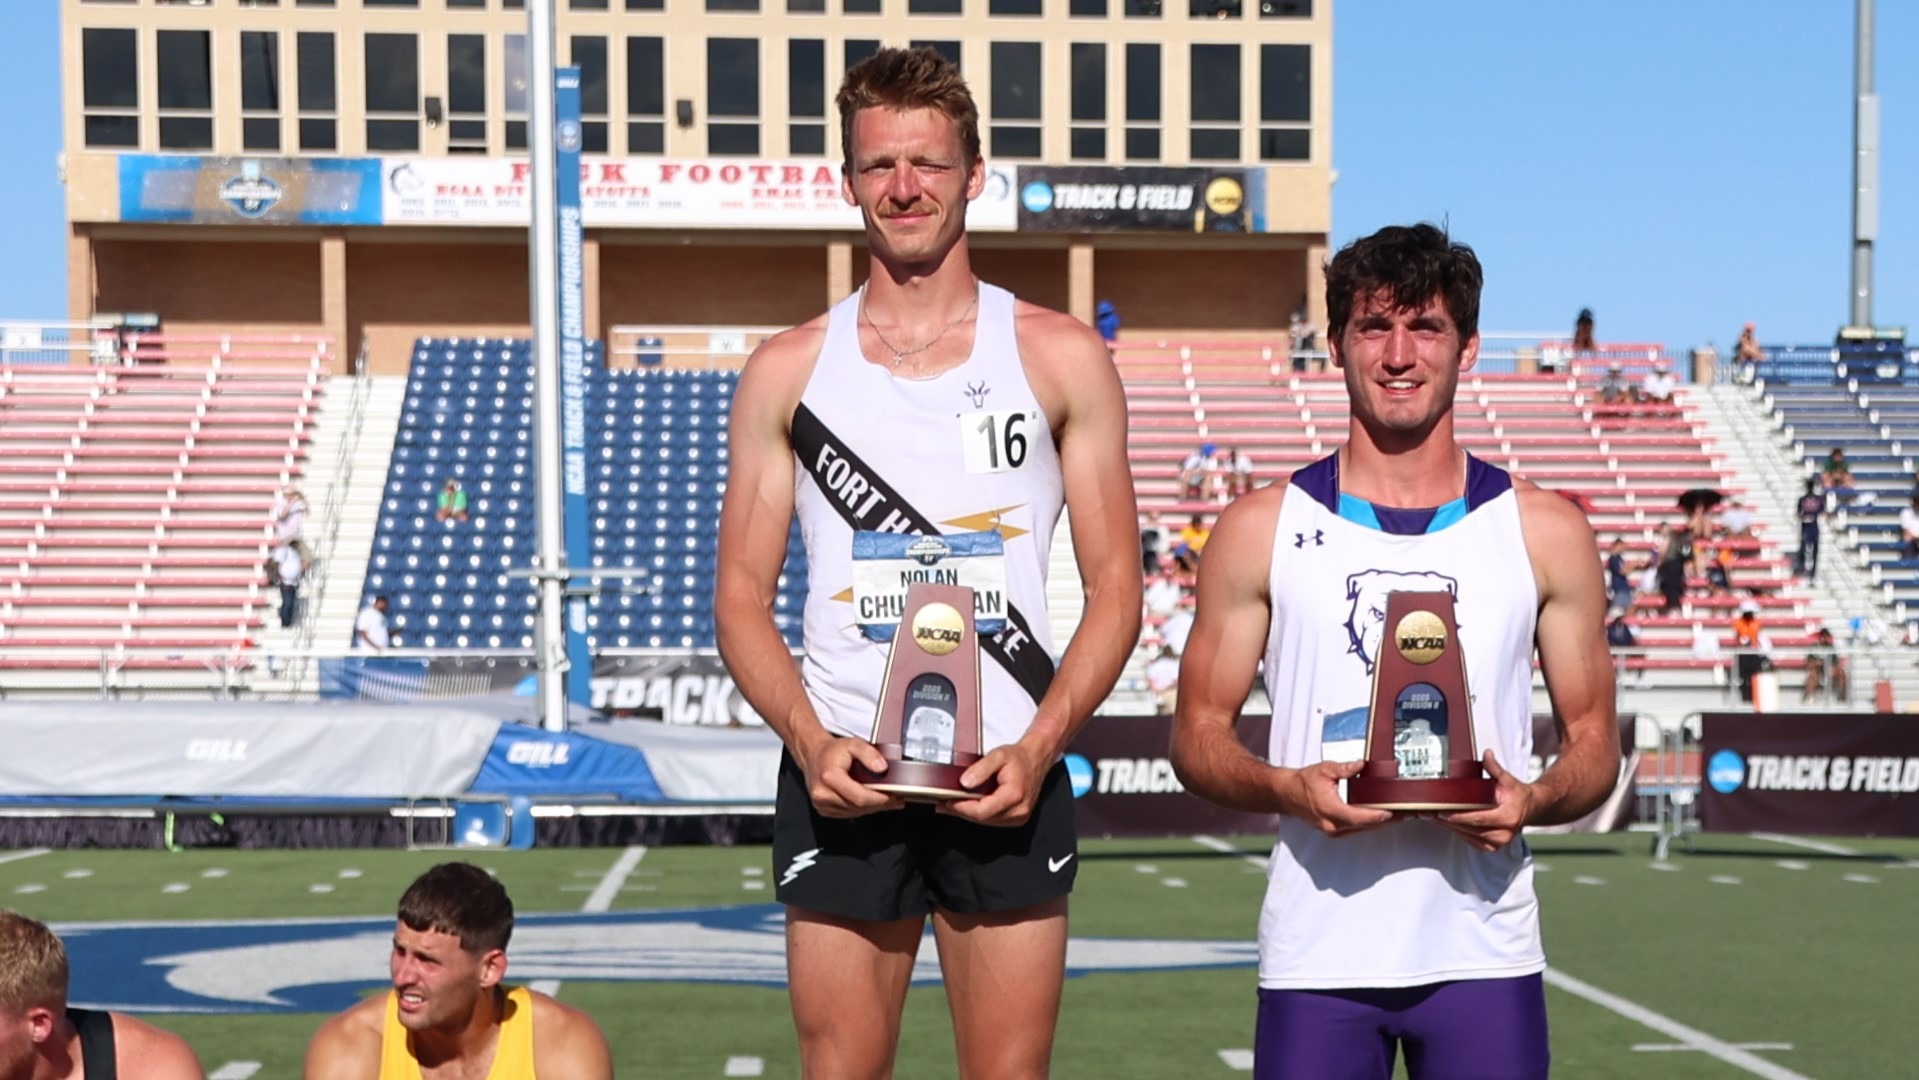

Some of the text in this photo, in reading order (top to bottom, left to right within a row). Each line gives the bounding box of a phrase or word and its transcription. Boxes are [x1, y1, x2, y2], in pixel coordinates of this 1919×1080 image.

[659, 164, 836, 184] FOOTBA
[1054, 184, 1118, 209] TRACK
[1119, 184, 1137, 210] &
[1137, 185, 1194, 210] FIELD
[559, 206, 583, 339] CHAMPIONSHIPS
[562, 340, 584, 384] FIELD
[563, 397, 585, 449] TRACK
[976, 412, 1028, 469] 16
[815, 443, 887, 519] FORT
[900, 568, 959, 590] NOLAN
[860, 590, 1001, 618] CHUAN
[915, 625, 962, 644] NCAA
[1400, 636, 1446, 651] NCAA
[1401, 701, 1433, 710] DIVISION
[185, 738, 249, 761] GILL
[505, 741, 570, 765] GILL
[1747, 755, 1829, 790] TRACK
[1828, 756, 1851, 791] &
[1850, 756, 1919, 792] FIELD
